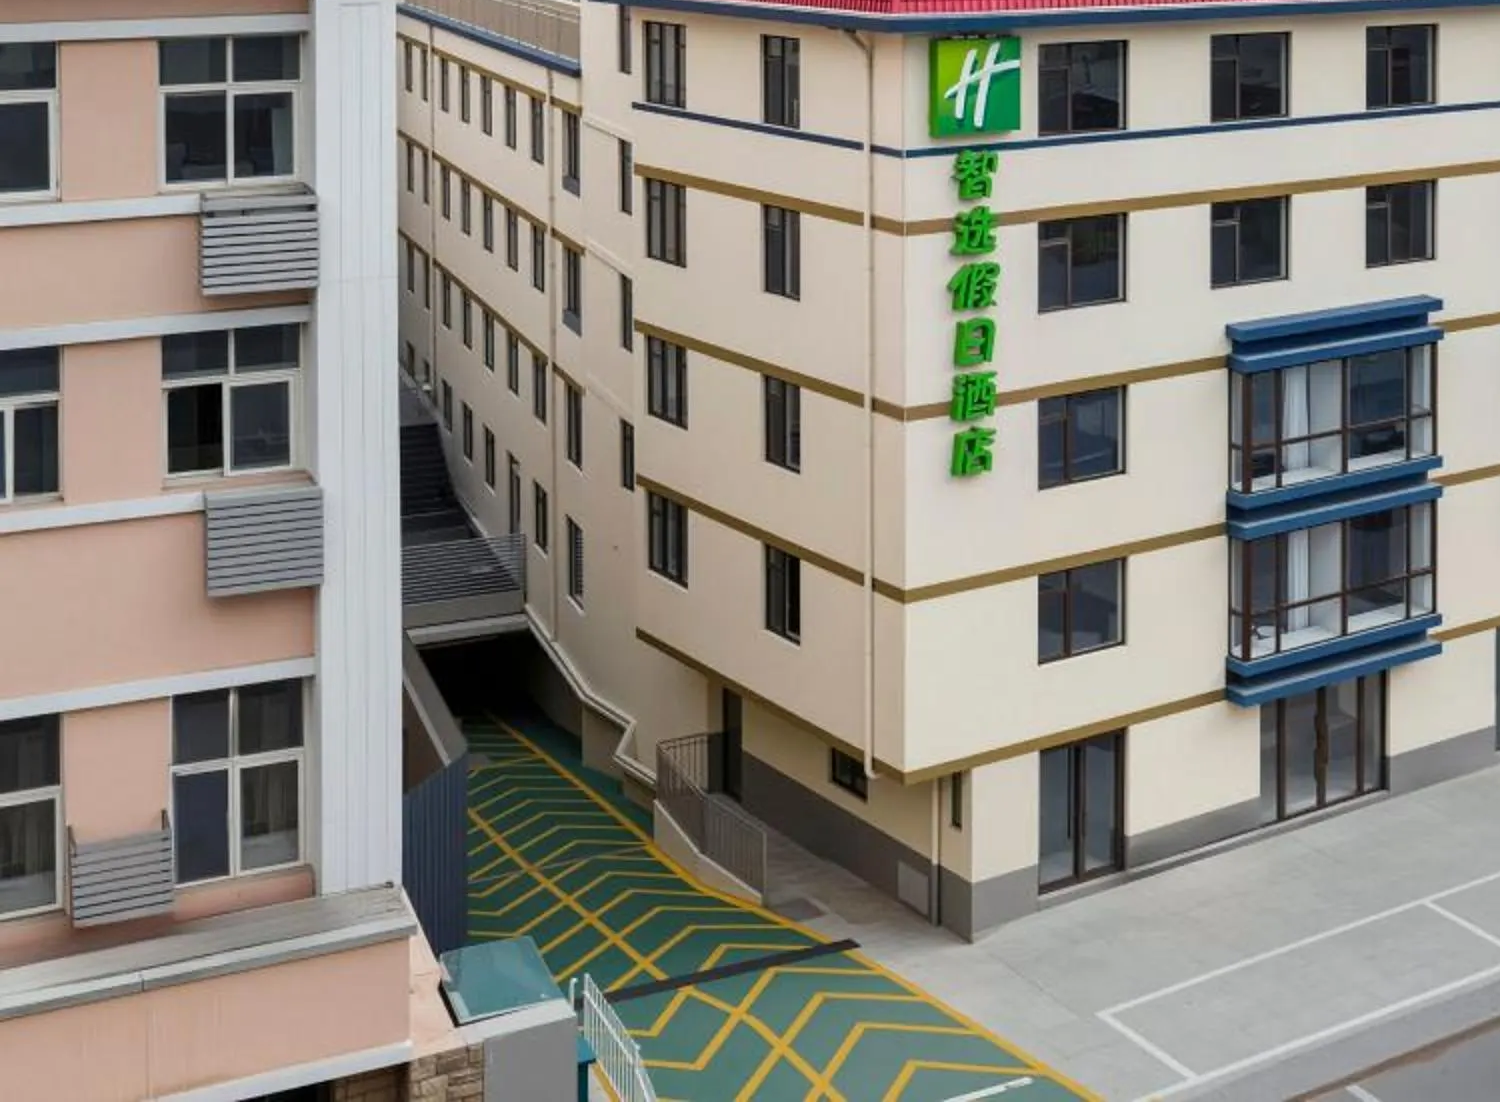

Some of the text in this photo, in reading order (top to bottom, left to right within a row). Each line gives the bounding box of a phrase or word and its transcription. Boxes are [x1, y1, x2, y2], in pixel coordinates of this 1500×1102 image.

[944, 43, 1020, 128] H
[948, 149, 1001, 476] 智选假日酒店
